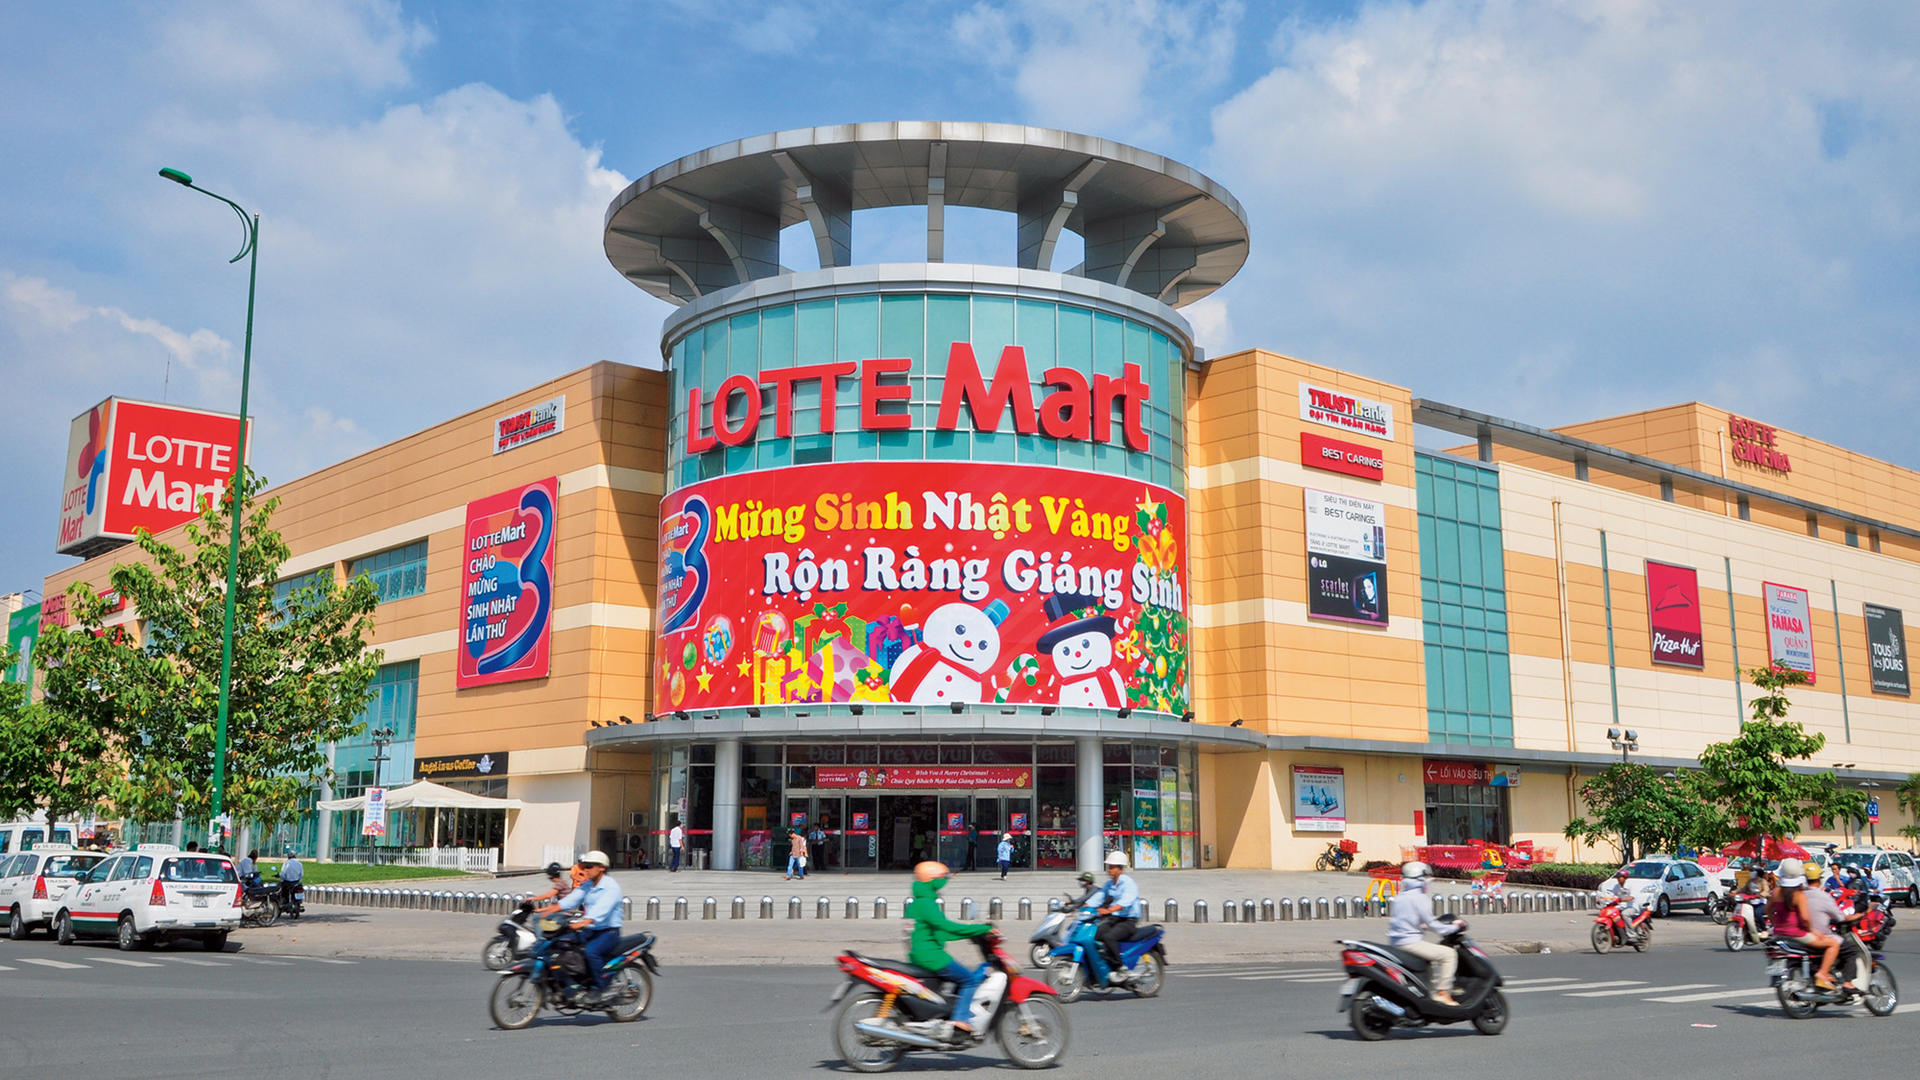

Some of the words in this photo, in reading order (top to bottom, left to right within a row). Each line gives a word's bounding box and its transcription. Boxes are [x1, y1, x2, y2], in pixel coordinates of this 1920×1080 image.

[687, 358, 912, 455] LOTTE
[936, 342, 1149, 452] Mart
[1730, 415, 1778, 447] LOTTE
[127, 432, 232, 472] LOTTE
[1322, 447, 1344, 460] BEST
[1347, 453, 1383, 469] CARINGS
[1734, 438, 1792, 472] CINEMA
[63, 484, 88, 512] LOTTE
[122, 468, 226, 514] Mart
[714, 500, 806, 544] Mừng
[814, 492, 913, 531] Sinh
[922, 491, 1032, 540] Nhật
[1040, 496, 1130, 551] Vàng
[1324, 507, 1343, 518] BEST
[1345, 511, 1376, 524] CARINGS
[59, 511, 84, 545] Mart
[470, 554, 496, 574] CHÀO
[468, 577, 498, 597] MỪNG
[763, 548, 850, 602] Rộn
[864, 546, 989, 601] Ràng
[1003, 549, 1122, 610] Giáng
[1132, 562, 1183, 613] Sinh
[1321, 577, 1349, 593] scarlet
[467, 602, 489, 620] SINH
[490, 596, 517, 617] NHẬT
[485, 619, 507, 639] THỨ
[1771, 613, 1804, 633] FAHASA
[1653, 632, 1680, 653] Pizza
[1680, 637, 1700, 656] Hut
[1872, 643, 1891, 657] TOUS
[1873, 655, 1883, 668] les
[1882, 658, 1903, 671] JOURS
